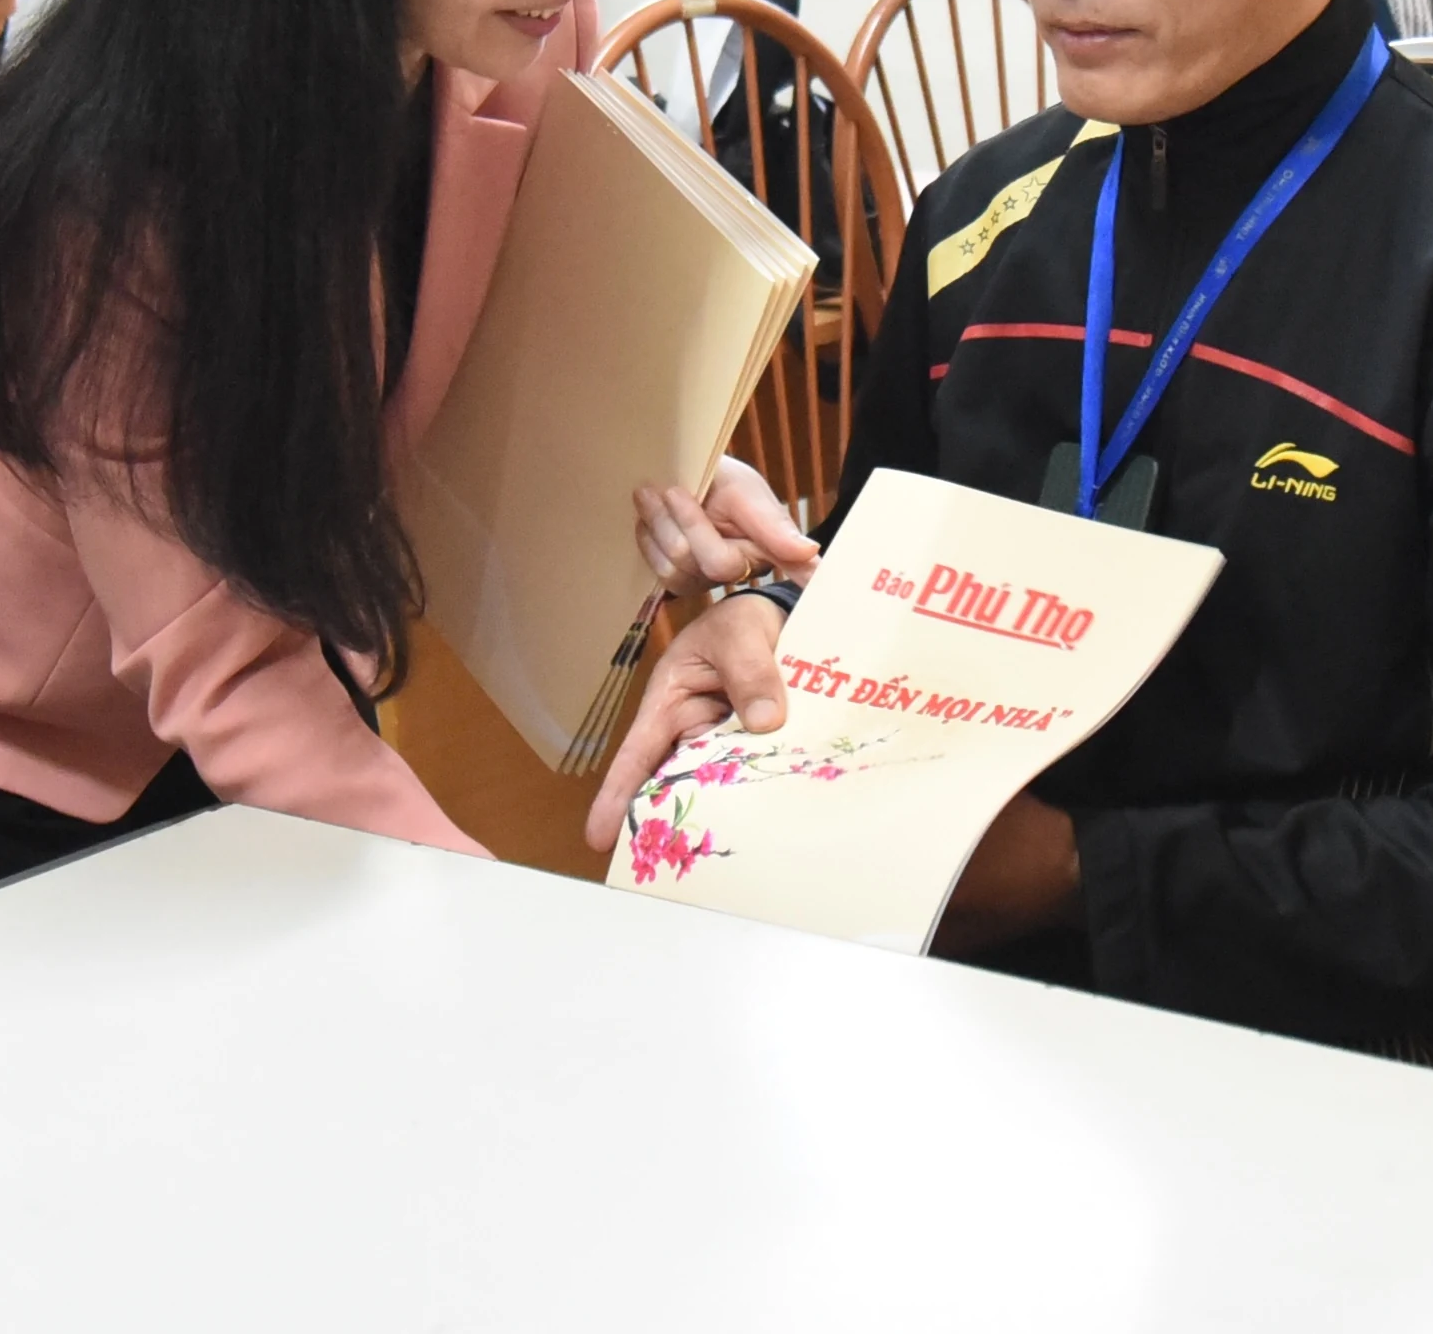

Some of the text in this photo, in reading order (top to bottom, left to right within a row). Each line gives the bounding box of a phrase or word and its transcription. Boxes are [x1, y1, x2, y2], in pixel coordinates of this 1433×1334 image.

[1250, 472, 1337, 502] LI-NING
[871, 563, 1095, 650] Báo Phú Thọ
[847, 674, 922, 712] ĐẾN
[916, 692, 986, 726] MỌI
